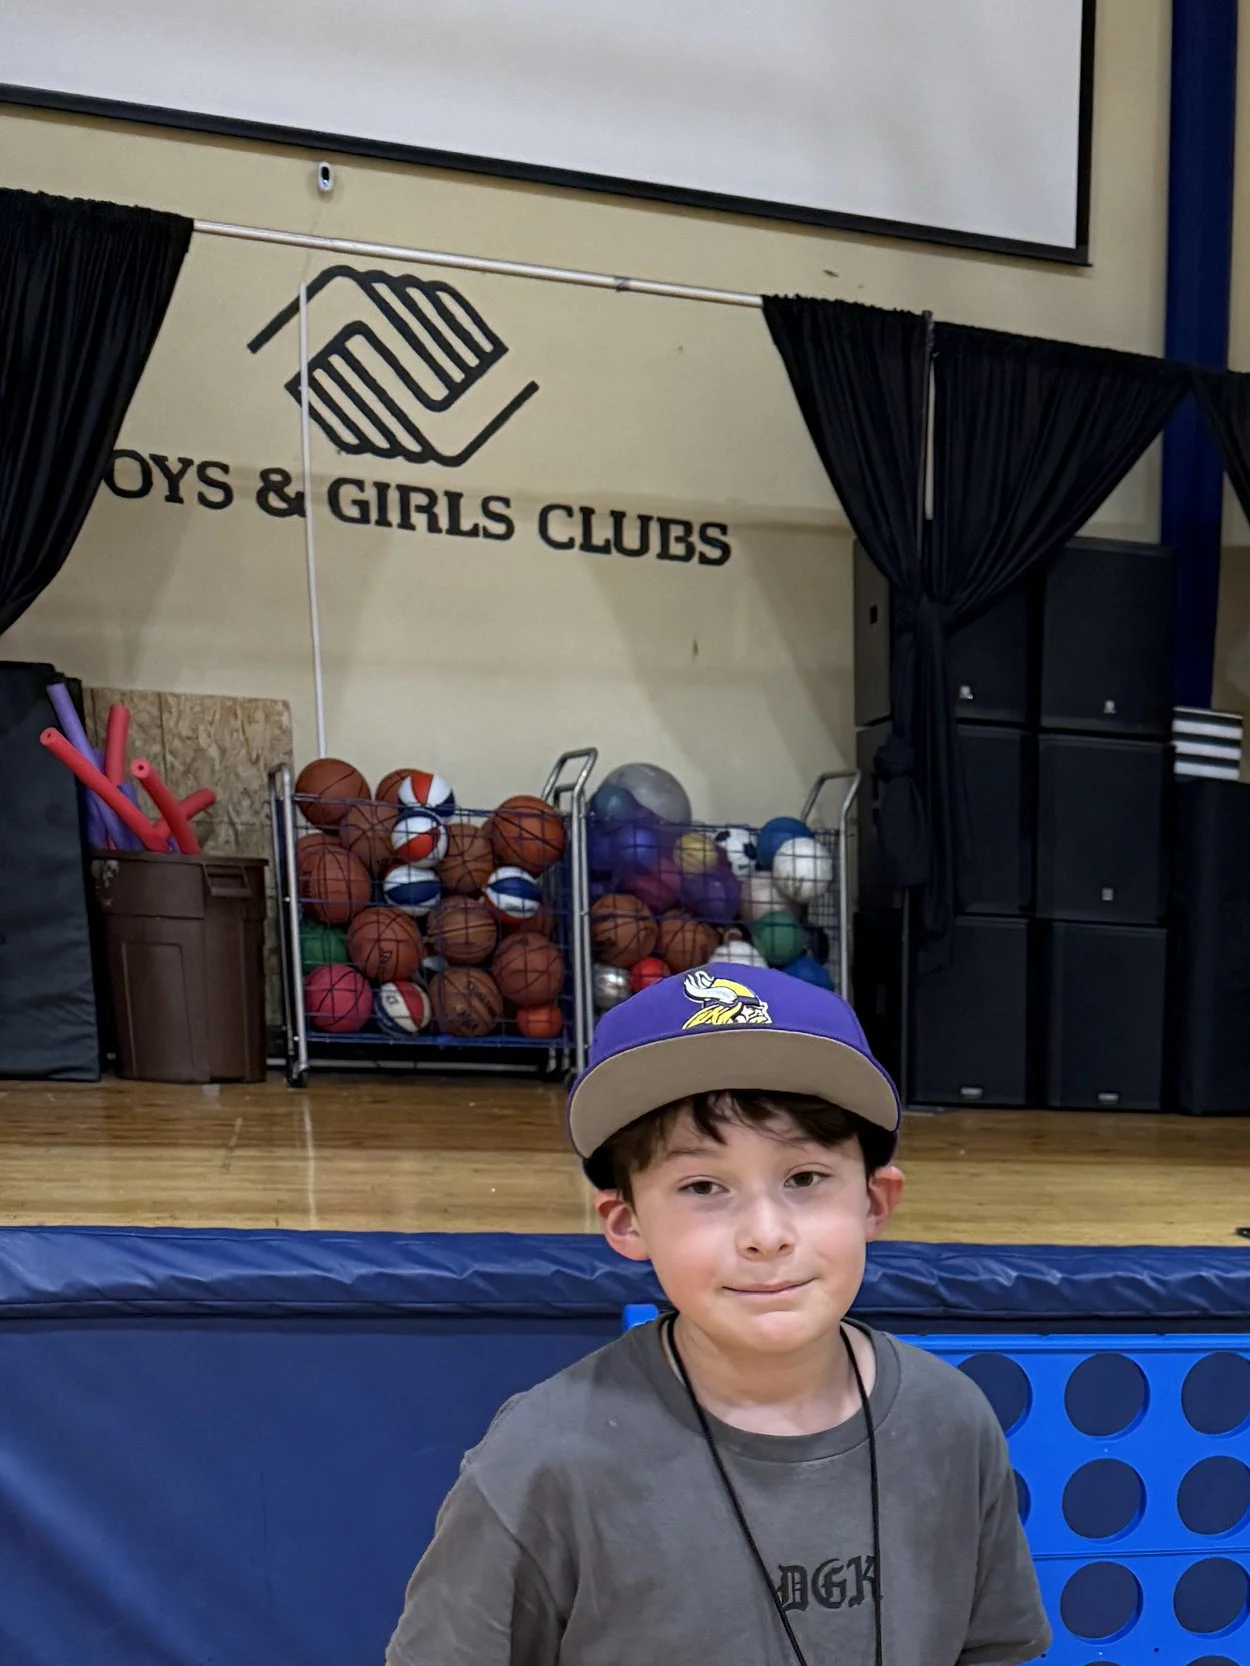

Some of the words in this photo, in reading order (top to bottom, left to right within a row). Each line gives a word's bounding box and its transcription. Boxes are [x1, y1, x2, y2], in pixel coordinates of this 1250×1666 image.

[104, 449, 233, 510] OYS
[256, 467, 308, 518] &
[327, 477, 515, 541] GIRLS
[538, 503, 731, 567] CLUBS
[777, 1555, 883, 1613] DGK
